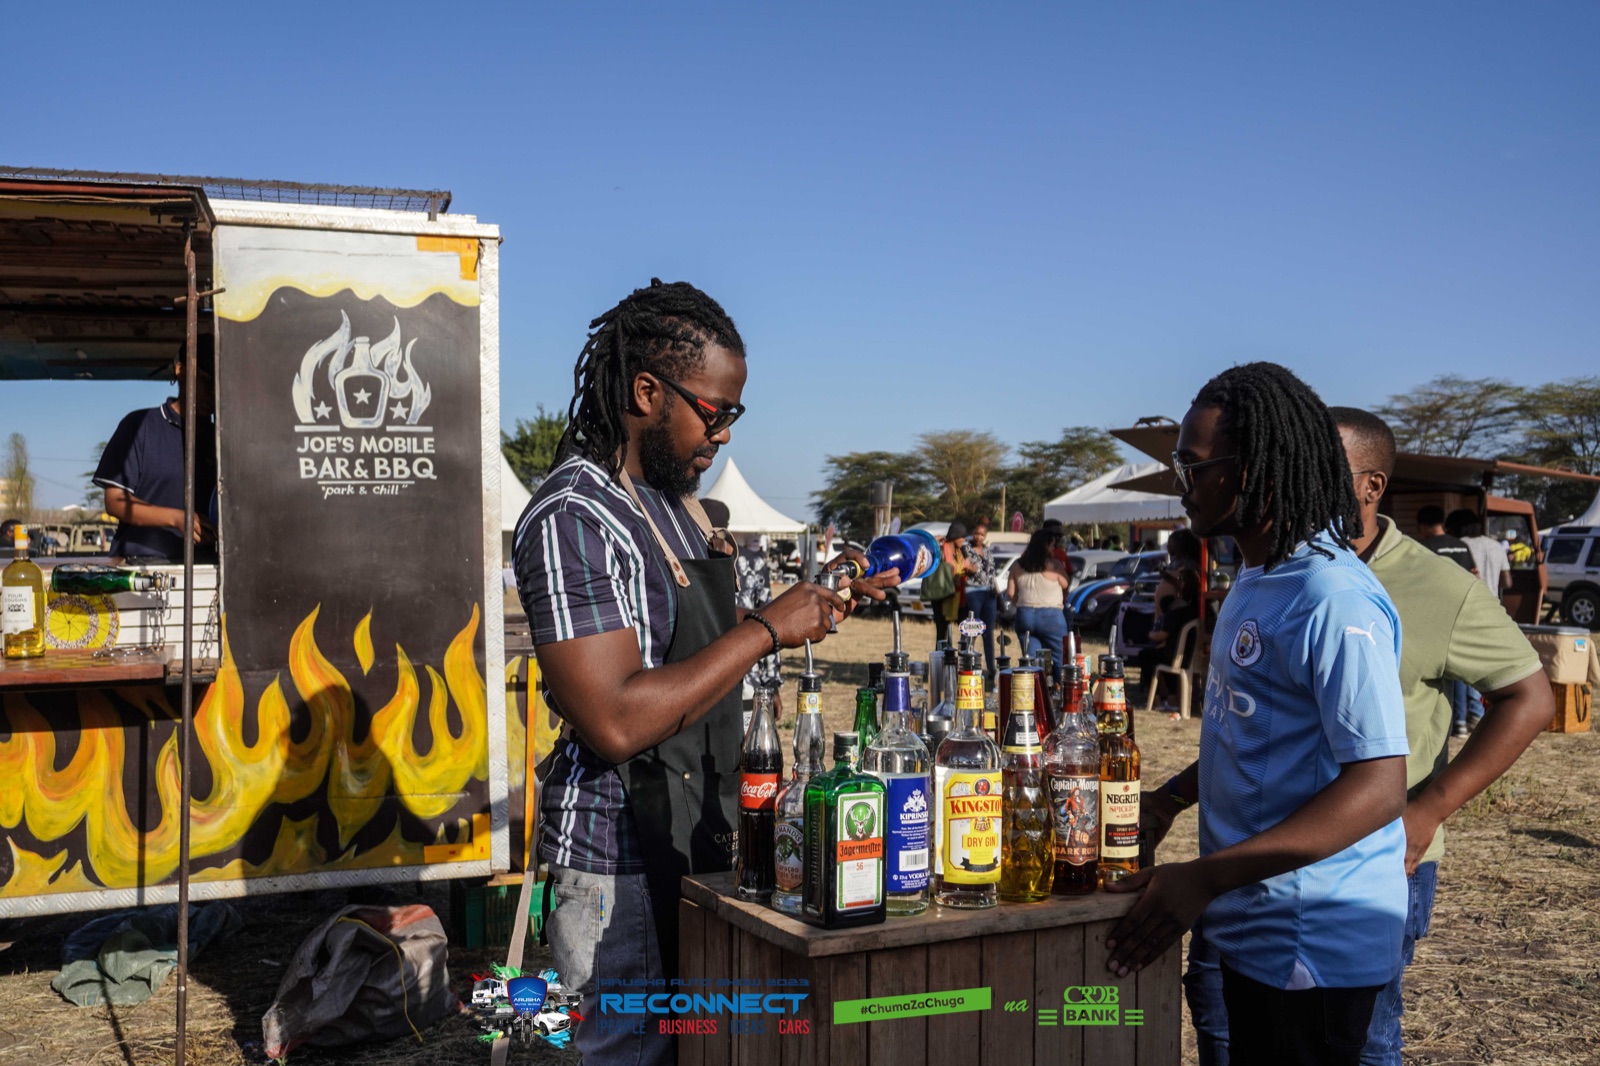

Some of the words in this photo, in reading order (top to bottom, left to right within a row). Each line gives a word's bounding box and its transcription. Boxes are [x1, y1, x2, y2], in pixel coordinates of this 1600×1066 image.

[297, 436, 355, 453] JOE'S
[360, 435, 435, 453] MOBILE
[299, 456, 352, 479] BAR
[354, 458, 369, 479] &
[374, 457, 437, 480] BBQ
[359, 486, 368, 495] &
[741, 781, 777, 798] Coca-Cola
[1051, 777, 1075, 793] Captain
[1109, 805, 1134, 813] SPICED
[967, 836, 983, 848] DRY
[985, 836, 996, 847] GIN
[840, 843, 881, 857] Jägermeister
[1055, 846, 1080, 856] DARK
